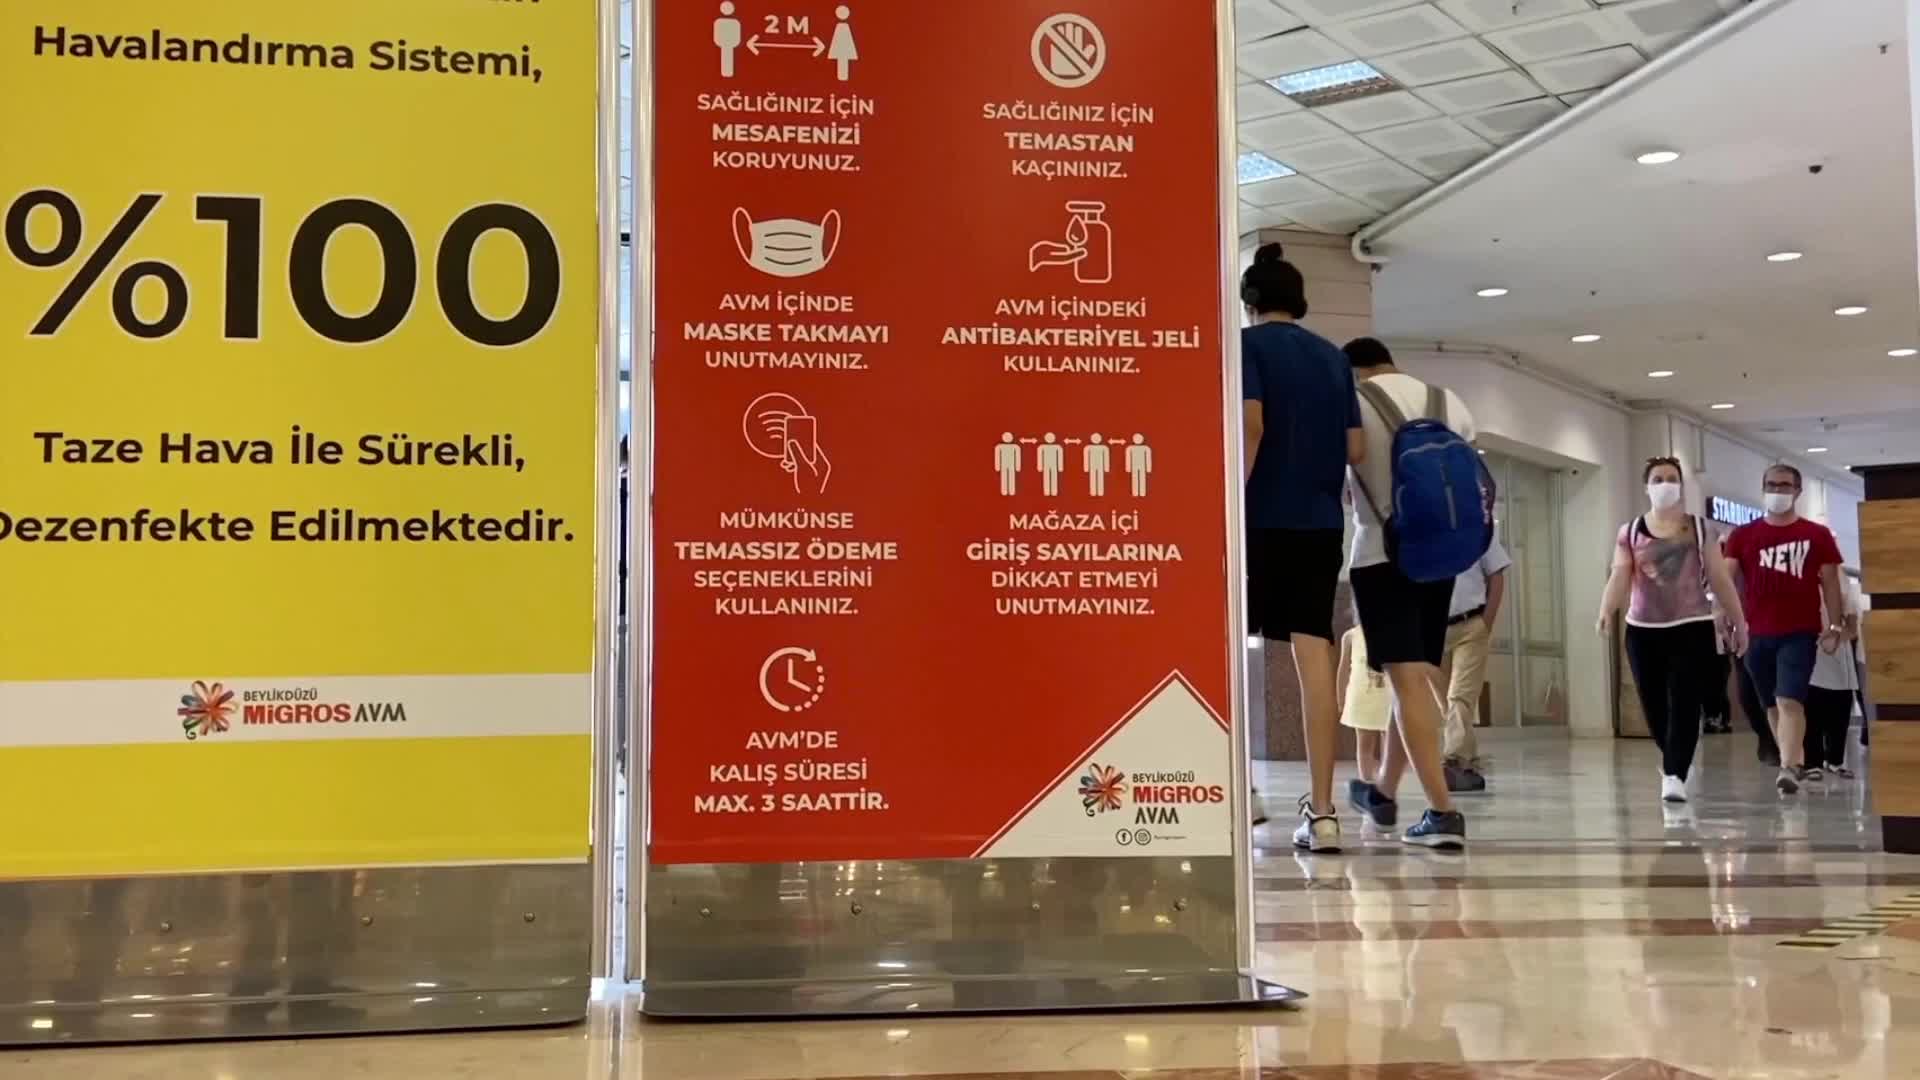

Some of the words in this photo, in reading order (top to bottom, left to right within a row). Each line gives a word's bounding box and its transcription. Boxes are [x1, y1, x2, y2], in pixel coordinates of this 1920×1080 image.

[764, 15, 779, 33] 2
[787, 16, 809, 34] M
[33, 25, 354, 69] Havalandırma
[368, 39, 542, 83] Sistemi,
[697, 91, 824, 113] SAĞLIĞINIZ
[830, 93, 874, 119] İÇİN
[983, 100, 1105, 122] SAĞLIĞINIZ
[1111, 102, 1153, 127] İÇİN
[712, 121, 860, 144] MESAFENİZİ
[1004, 131, 1133, 152] TEMASTAN
[712, 151, 860, 171] KORUYUNUZ.
[1011, 159, 1128, 180] KAÇININIZ.
[3, 187, 563, 348] %100
[719, 294, 769, 311] AVM
[777, 290, 853, 316] İÇİNDE
[995, 298, 1044, 316] AVM
[1051, 295, 1146, 320] İÇİNDEKİ
[684, 322, 771, 342] MASKE
[778, 324, 889, 343] TAKMAYI
[941, 322, 1146, 348] ANTİBAKTERİYEL
[1152, 325, 1200, 348] JELİ
[705, 351, 868, 369] UNUTMAYINIZ.
[1003, 355, 1140, 374] KULLANINIZ.
[34, 431, 143, 464] Taze
[160, 432, 274, 465] Hava
[290, 425, 343, 466] İle
[357, 433, 525, 472] Sürekli,
[269, 509, 575, 543] Edilmektedir.
[720, 507, 853, 529] MÜMKÜNSE
[1009, 510, 1105, 531] MAĞAZA
[1111, 510, 1139, 535] İÇİ
[674, 541, 800, 560] TEMASSIZ
[807, 537, 898, 560] ÖDEME
[966, 537, 1030, 566] GİRİŞ
[1037, 543, 1182, 561] SAYILARINA
[1759, 539, 1810, 579] NEW
[694, 566, 872, 592] SEÇENEKLERİNİ
[991, 567, 1072, 588] DİKKAT
[1079, 568, 1158, 588] ETMEYİ
[715, 597, 858, 615] KULLANINIZ.
[996, 598, 1155, 615] UNUTMAYINIZ.
[243, 688, 318, 702] BEYLİKDÜZÜ
[710, 764, 777, 786] KALIŞ
[784, 757, 867, 781] SÜRESİ
[1132, 770, 1194, 783] BEYLİKDÜZÜ
[694, 795, 755, 813] MAX.
[761, 794, 775, 812] 3
[782, 787, 889, 812] SAATTİR.
